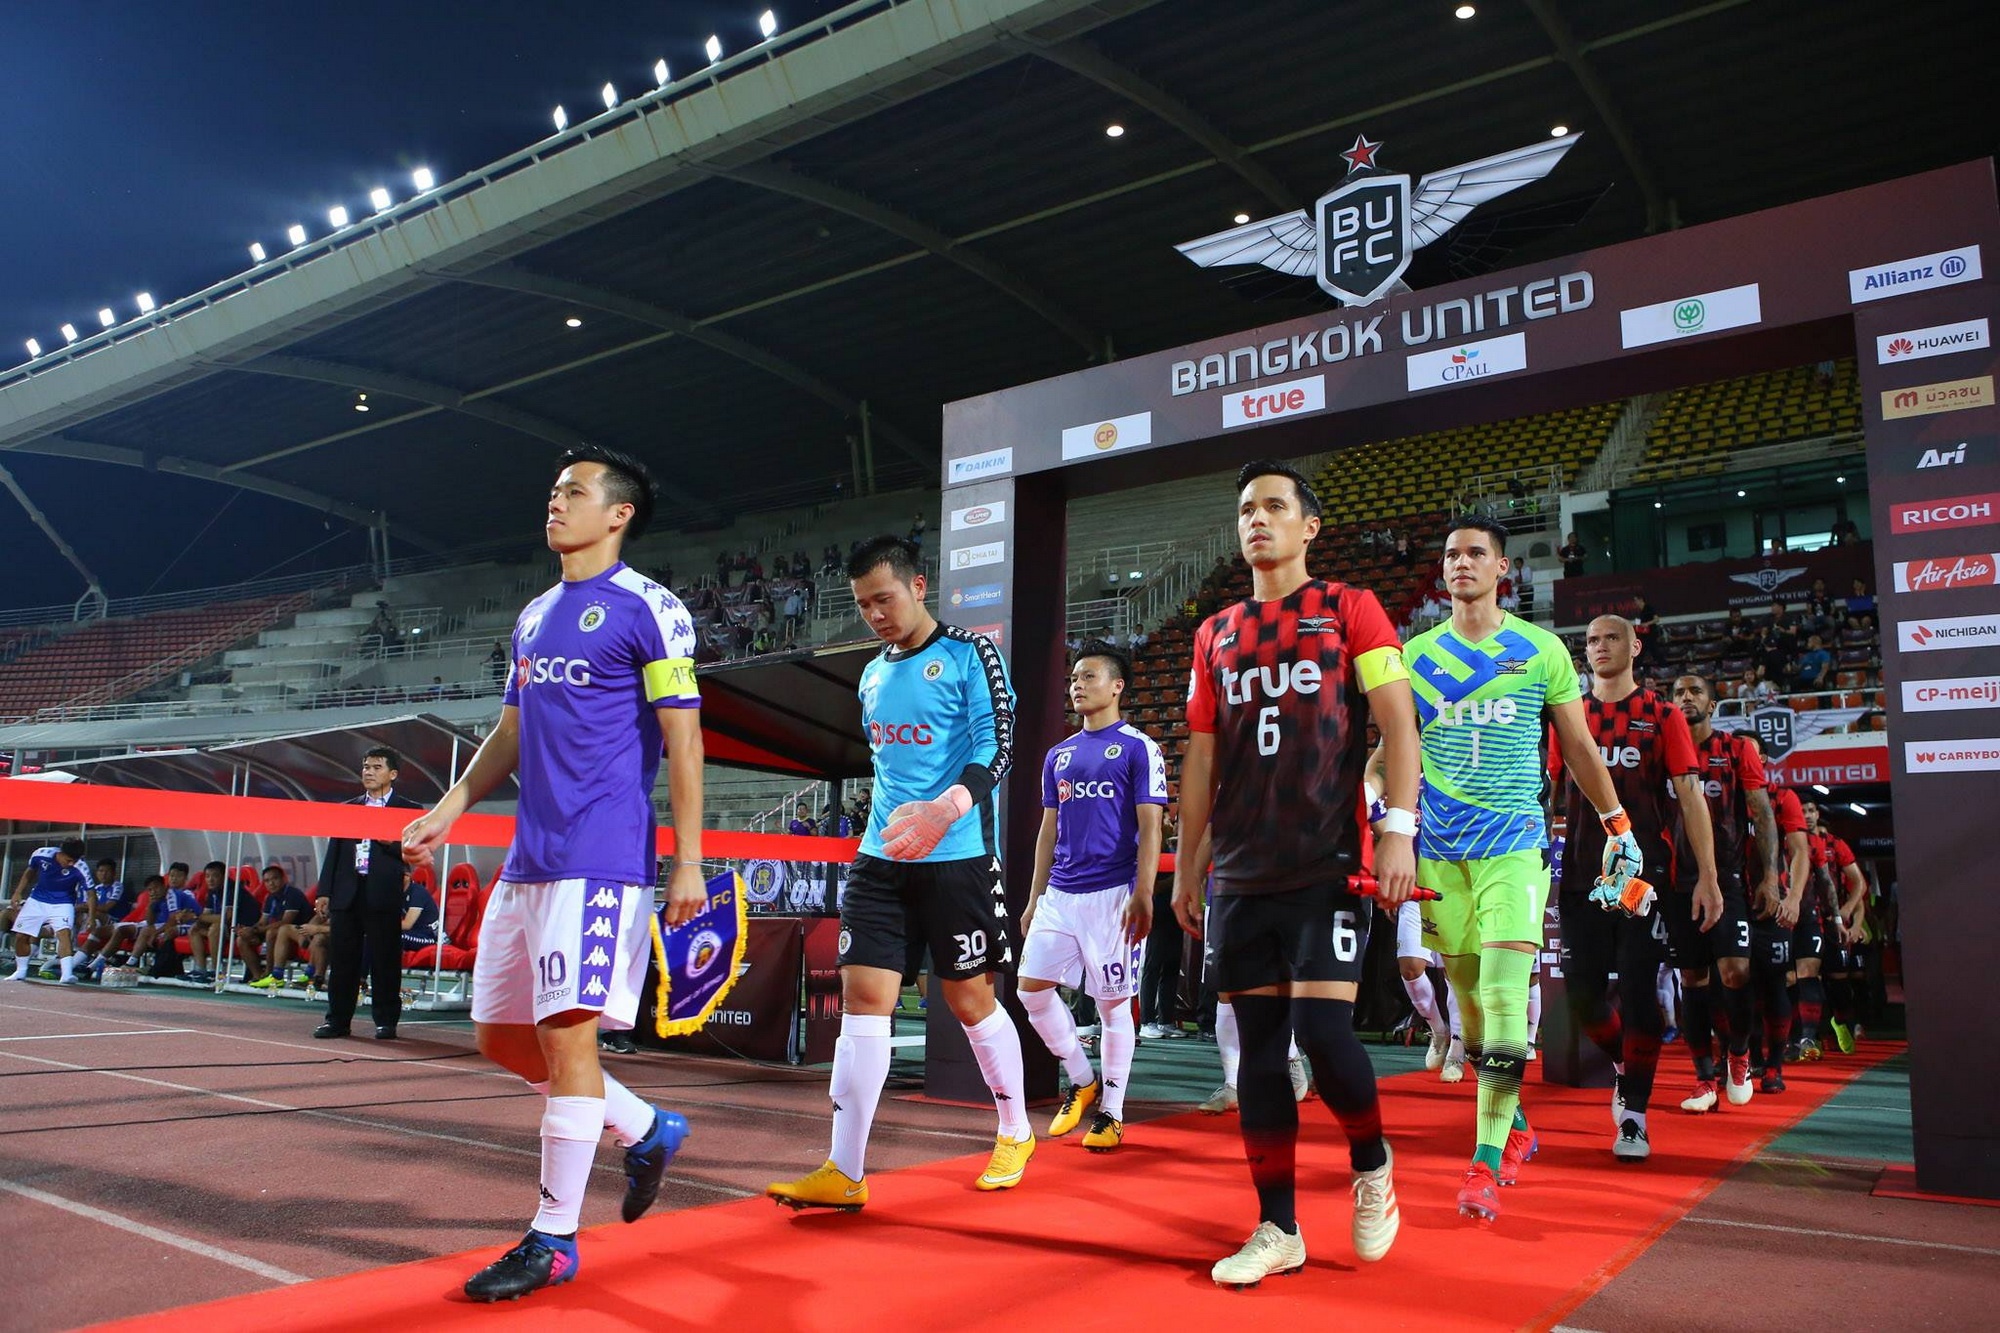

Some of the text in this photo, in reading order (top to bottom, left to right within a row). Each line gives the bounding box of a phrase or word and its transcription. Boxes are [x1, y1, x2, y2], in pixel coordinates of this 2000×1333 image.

[1333, 196, 1394, 241] BU
[1333, 230, 1394, 275] FC
[1864, 265, 1933, 290] Allianz
[1172, 271, 1595, 397] BANGKOK UNITED
[1917, 331, 1979, 350] HUAWEI
[1242, 389, 1305, 418] true
[1097, 429, 1114, 442] CP
[965, 456, 1005, 472] DAIKIN
[1916, 443, 1968, 469] Ari
[1903, 502, 1991, 525] RICOH
[1935, 625, 1996, 638] NICHIBAN
[533, 656, 590, 686] SCG
[1222, 659, 1322, 705] true
[1434, 696, 1517, 726] true
[885, 724, 933, 746] SCG
[1257, 706, 1281, 756] 6
[1758, 717, 1787, 732] BU
[1792, 764, 1877, 783] UNITED
[1075, 781, 1115, 798] SCG
[712, 890, 731, 910] FC
[1333, 910, 1357, 962] 6
[1651, 911, 1669, 944] 4
[1737, 921, 1748, 947] 3
[953, 930, 987, 962] 30
[1771, 940, 1788, 964] 31
[1812, 936, 1821, 953] 7
[539, 951, 566, 992] 10
[954, 956, 986, 970] Kappa
[1103, 962, 1125, 985] 19
